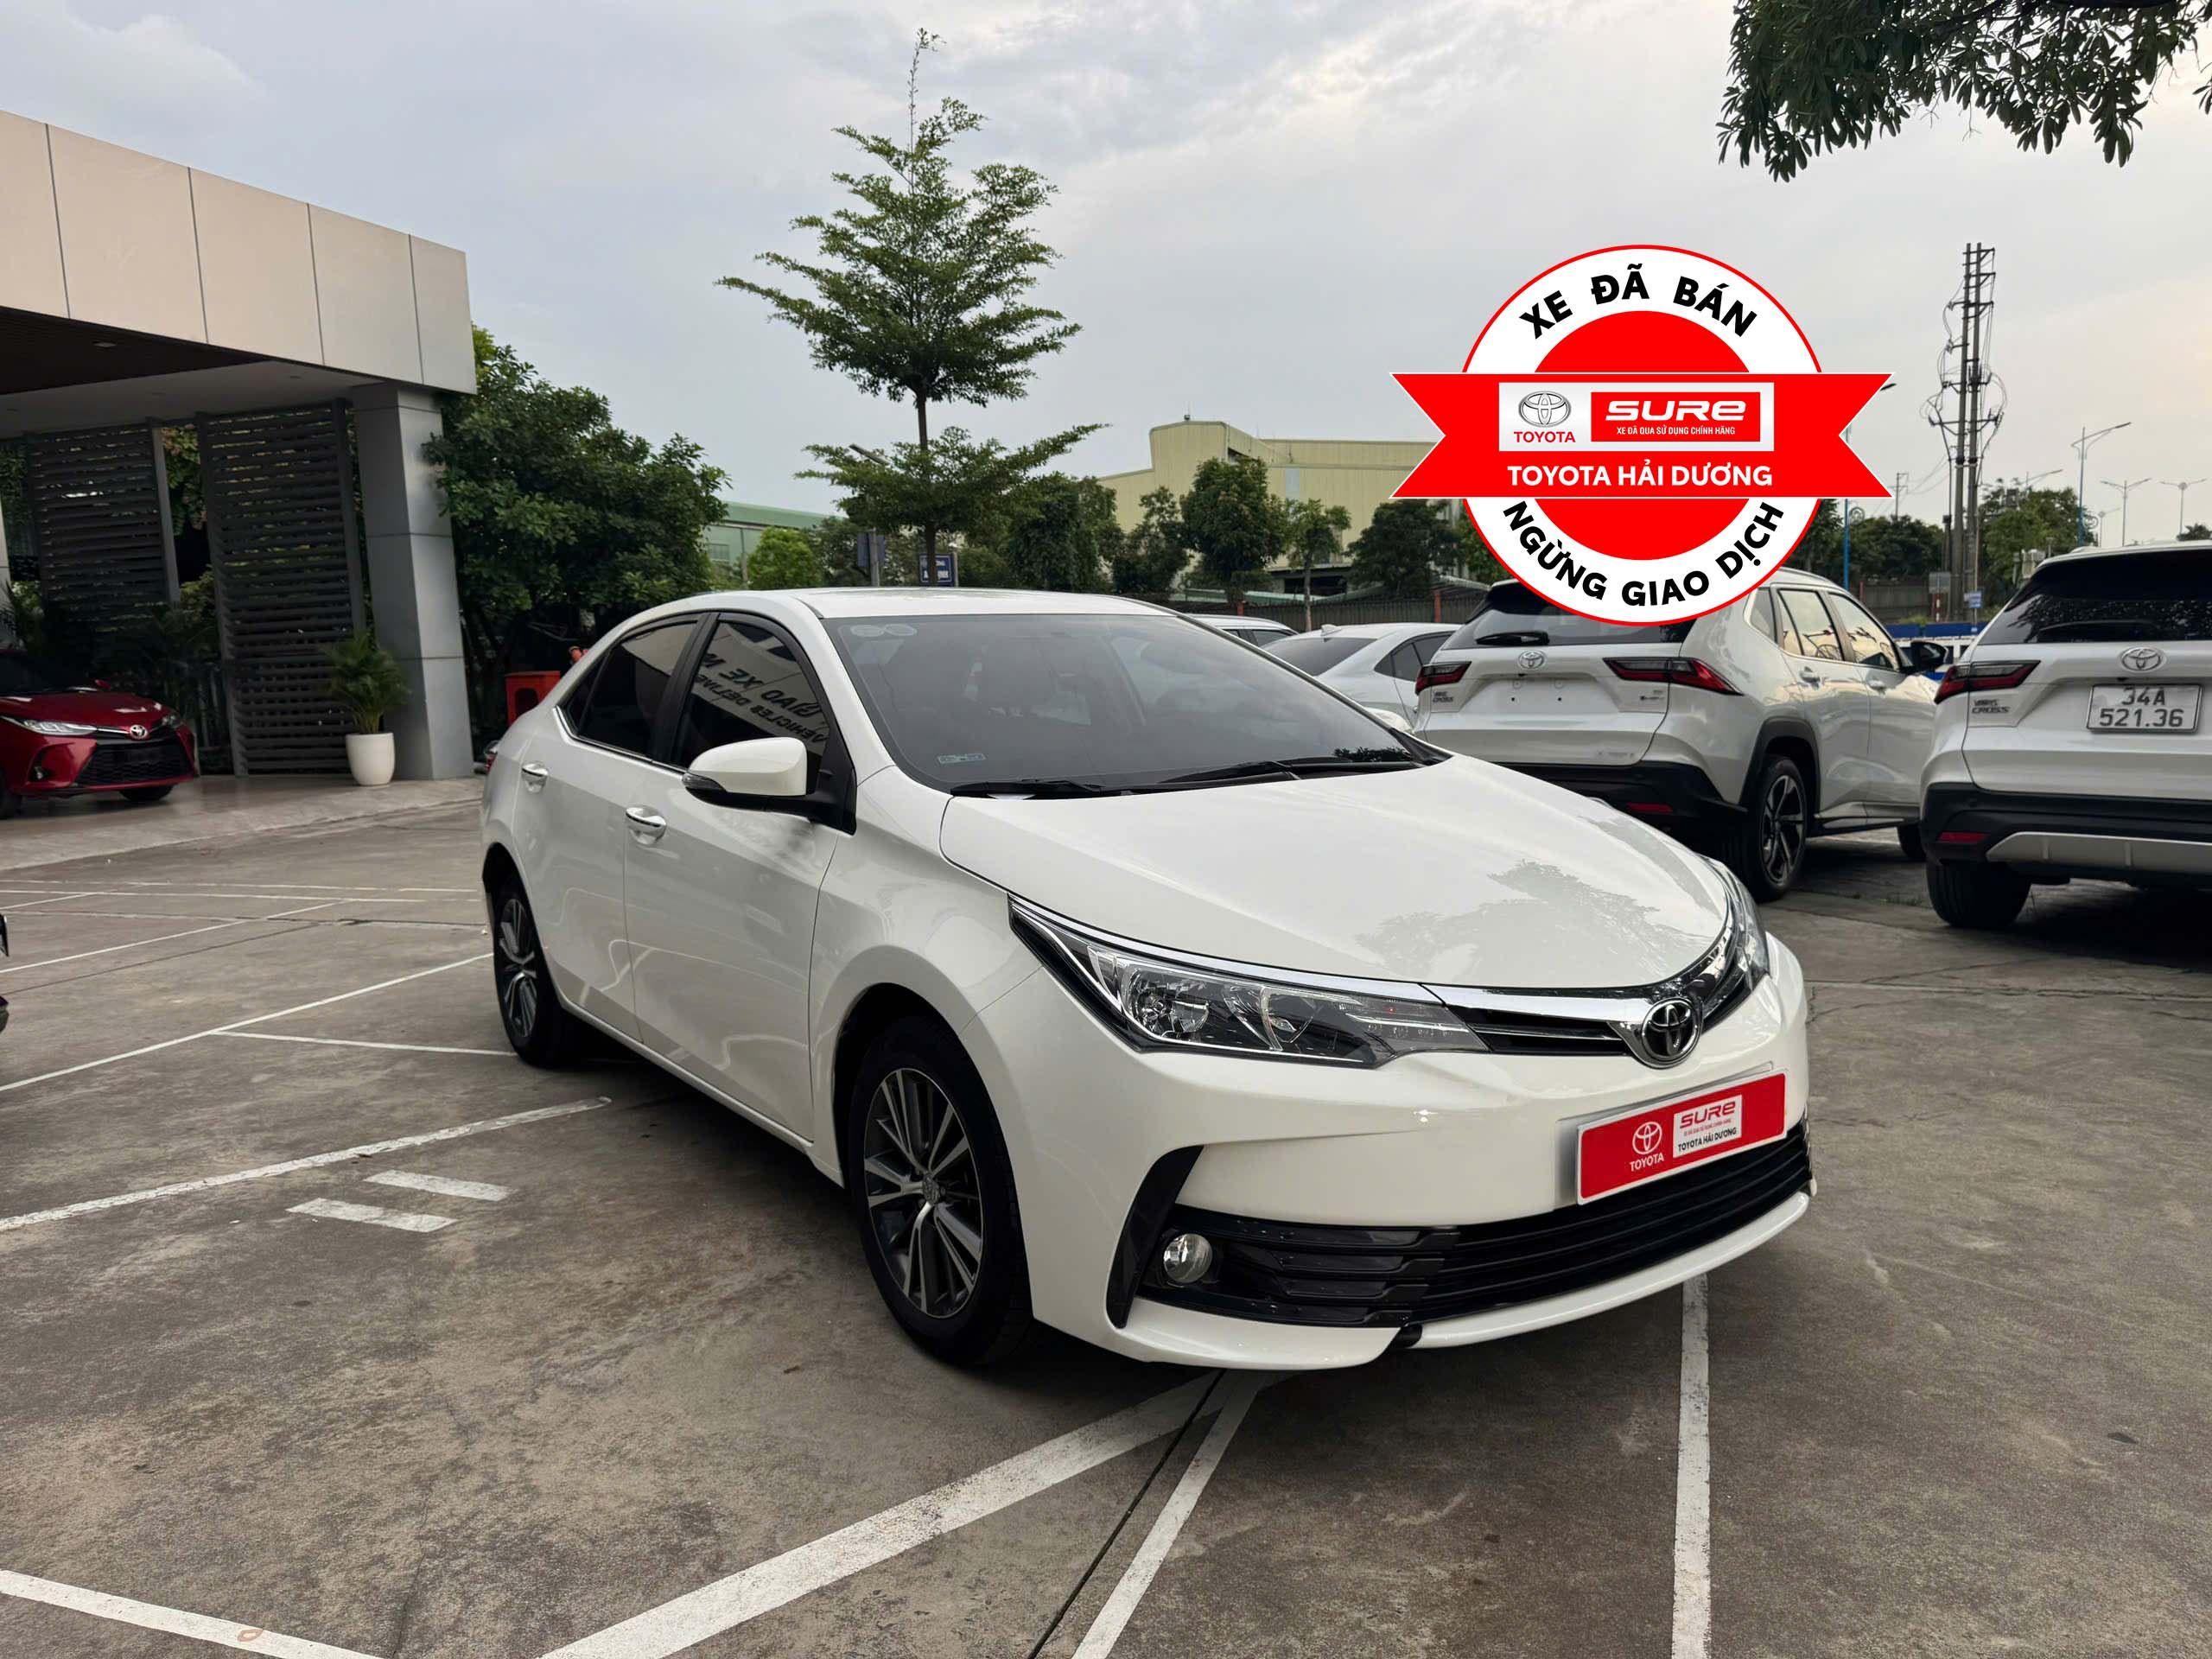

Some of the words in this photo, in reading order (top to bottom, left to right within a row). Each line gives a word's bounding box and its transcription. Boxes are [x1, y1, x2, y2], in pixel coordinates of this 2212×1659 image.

[2122, 688, 2165, 706] 34A
[2100, 708, 2184, 728] 521.36
[1680, 1101, 1735, 1128] SURE
[1678, 1138, 1702, 1152] TOYOTA
[1630, 1153, 1664, 1172] TOYOTA
